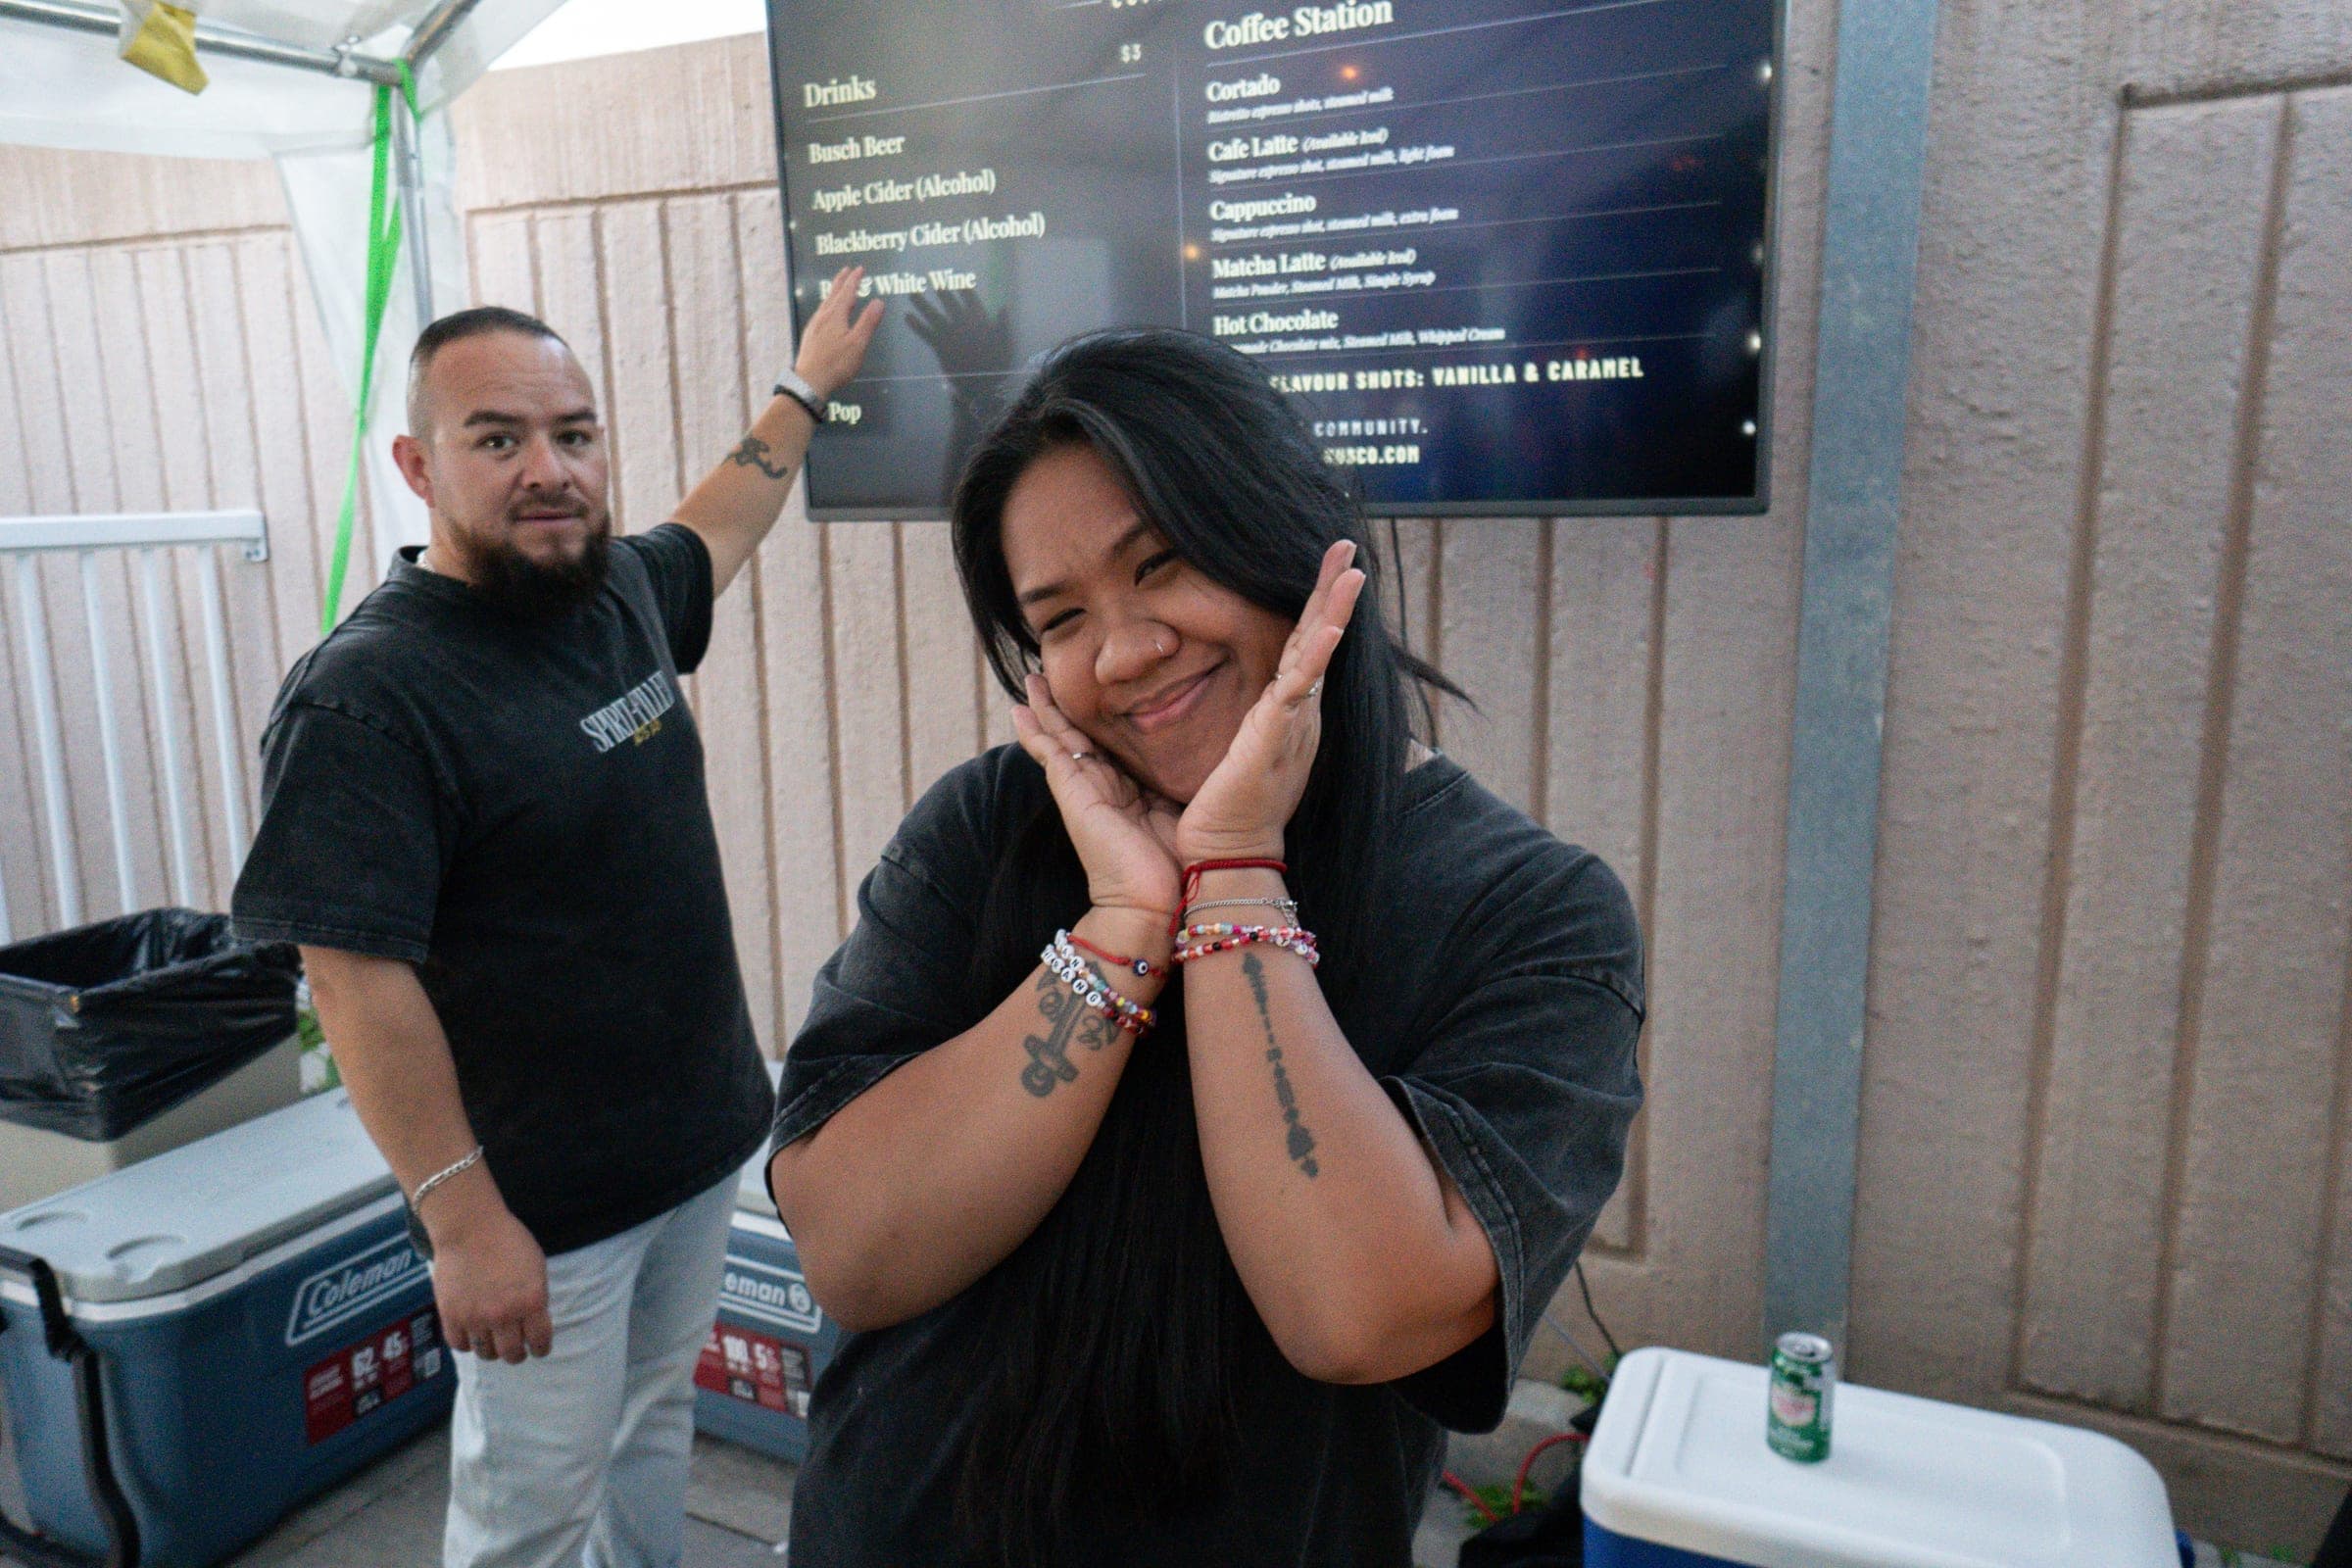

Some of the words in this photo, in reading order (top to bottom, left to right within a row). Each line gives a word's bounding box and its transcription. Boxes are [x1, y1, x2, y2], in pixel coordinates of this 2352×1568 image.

[1204, 12, 1289, 49] Coffee
[1294, 0, 1394, 36] Station
[804, 74, 876, 108] Drinks
[1205, 74, 1281, 102] Cortado
[808, 137, 860, 165] Busch
[863, 135, 906, 158] Beer
[1250, 135, 1298, 158] Latte
[811, 185, 861, 213] Apple
[865, 179, 914, 205] Cider
[916, 169, 997, 202] (Alcohol)
[1210, 193, 1316, 223] Cappuccino
[816, 229, 907, 257] Blackberry
[909, 223, 960, 248] Cider
[963, 213, 1046, 244] (Alcohol)
[1212, 254, 1277, 279] Matcha
[1279, 252, 1326, 273] Latte
[875, 271, 927, 295] White
[929, 268, 977, 291] Wine
[1213, 314, 1248, 336] Hot
[1249, 308, 1339, 334] Chocolate
[1354, 368, 1424, 389] SHOTS:
[1432, 364, 1516, 386] VANILLA
[1524, 363, 1540, 382] &
[1547, 357, 1644, 381] CARAMEL
[827, 402, 861, 425] Pop
[1313, 417, 1428, 437] COMMUNITY.
[308, 1250, 412, 1316] Coleman
[724, 1273, 785, 1306] eman
